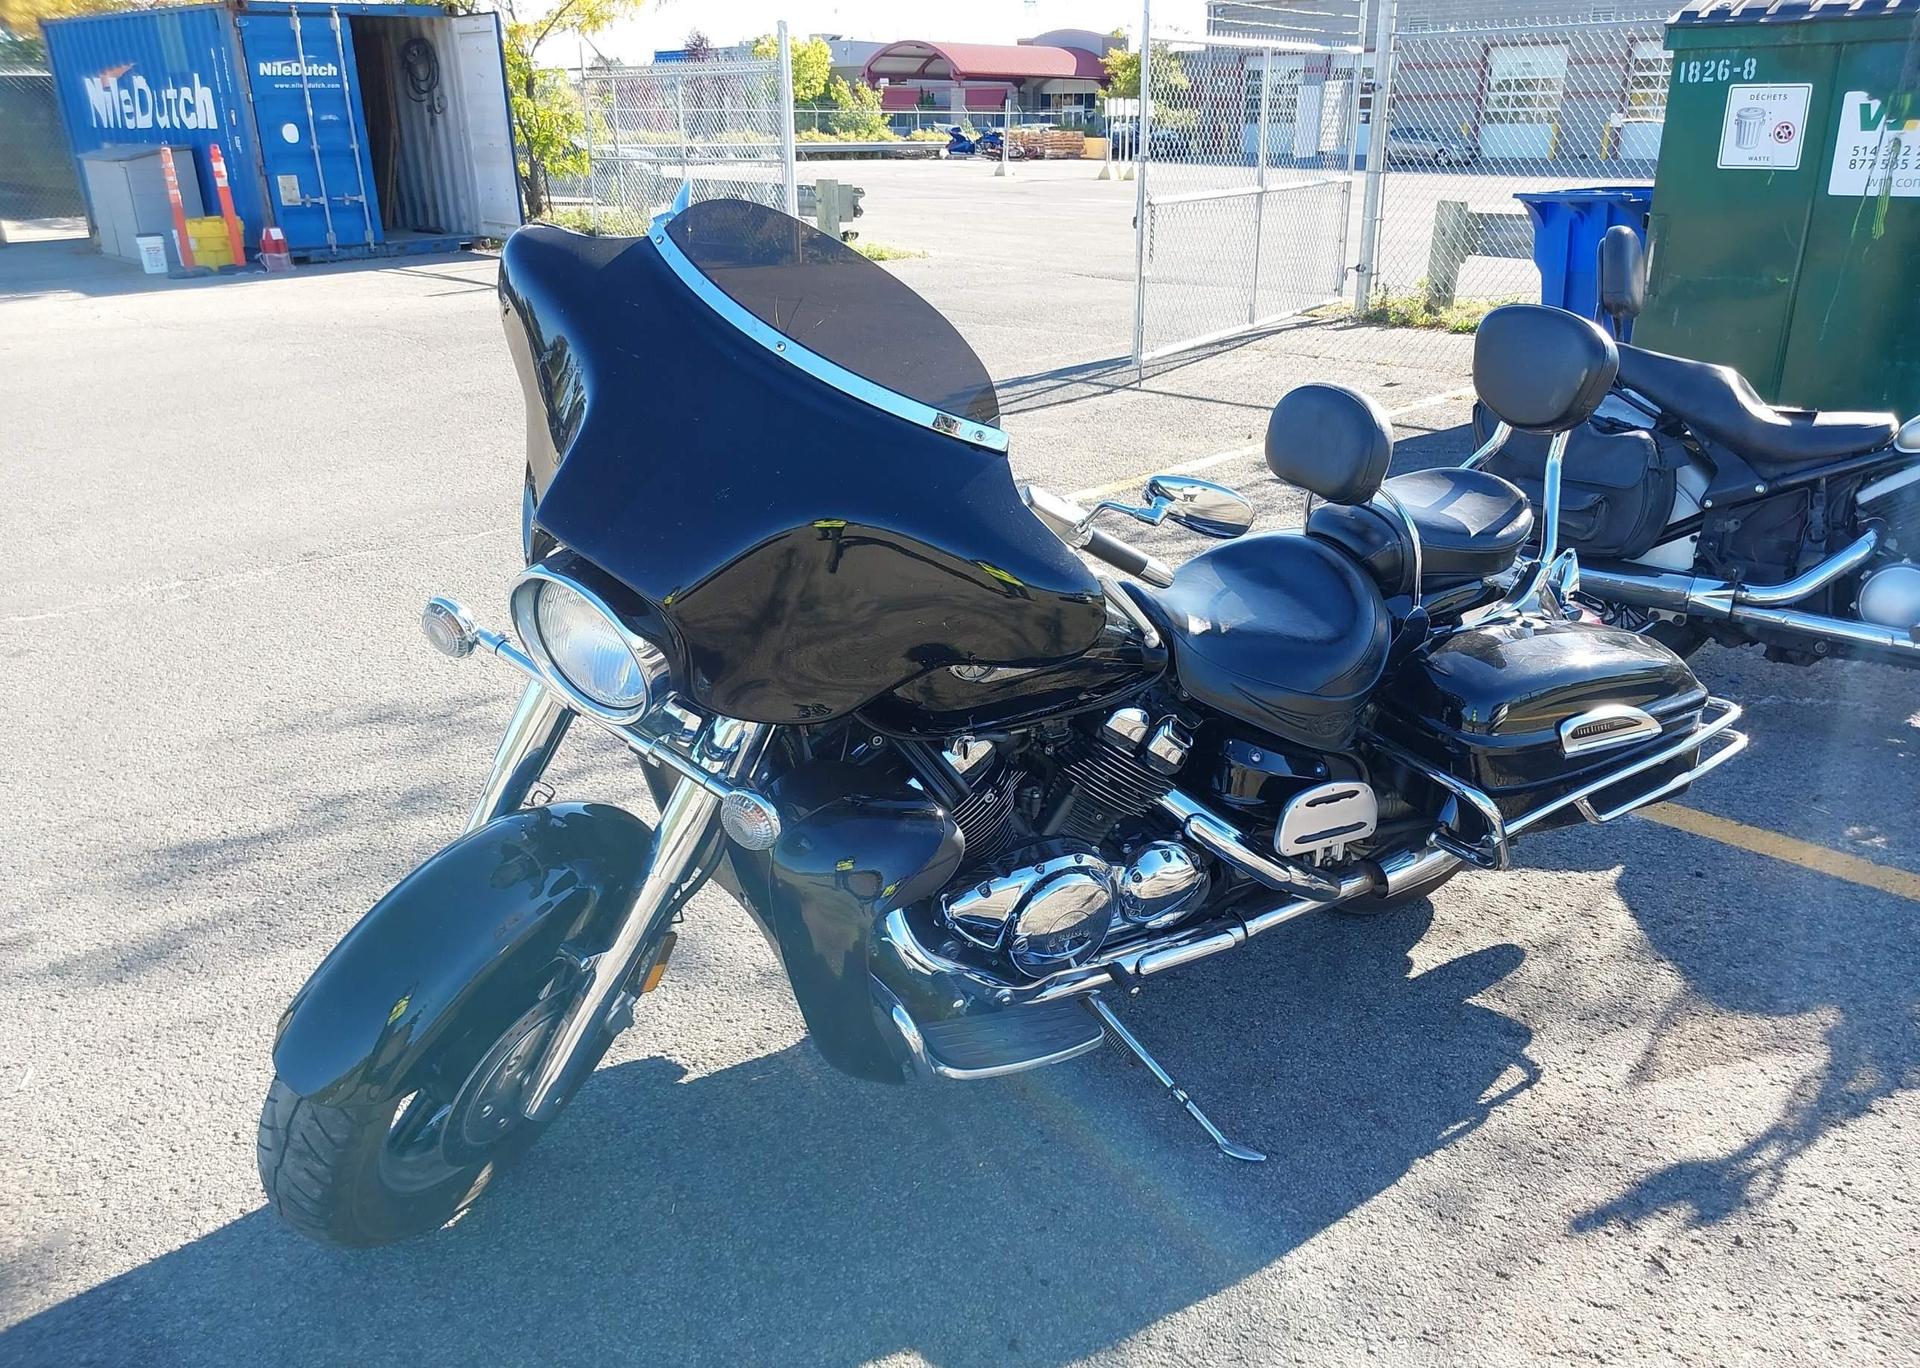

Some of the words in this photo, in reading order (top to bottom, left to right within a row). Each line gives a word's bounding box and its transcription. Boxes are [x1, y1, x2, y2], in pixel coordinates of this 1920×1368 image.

[259, 62, 338, 77] NileDutch
[1679, 58, 1757, 83] 1826-8
[84, 72, 218, 129] NileDutch
[1749, 93, 1788, 102] DÉCHETS
[1851, 145, 1878, 157] 514
[1848, 158, 1876, 170] 877
